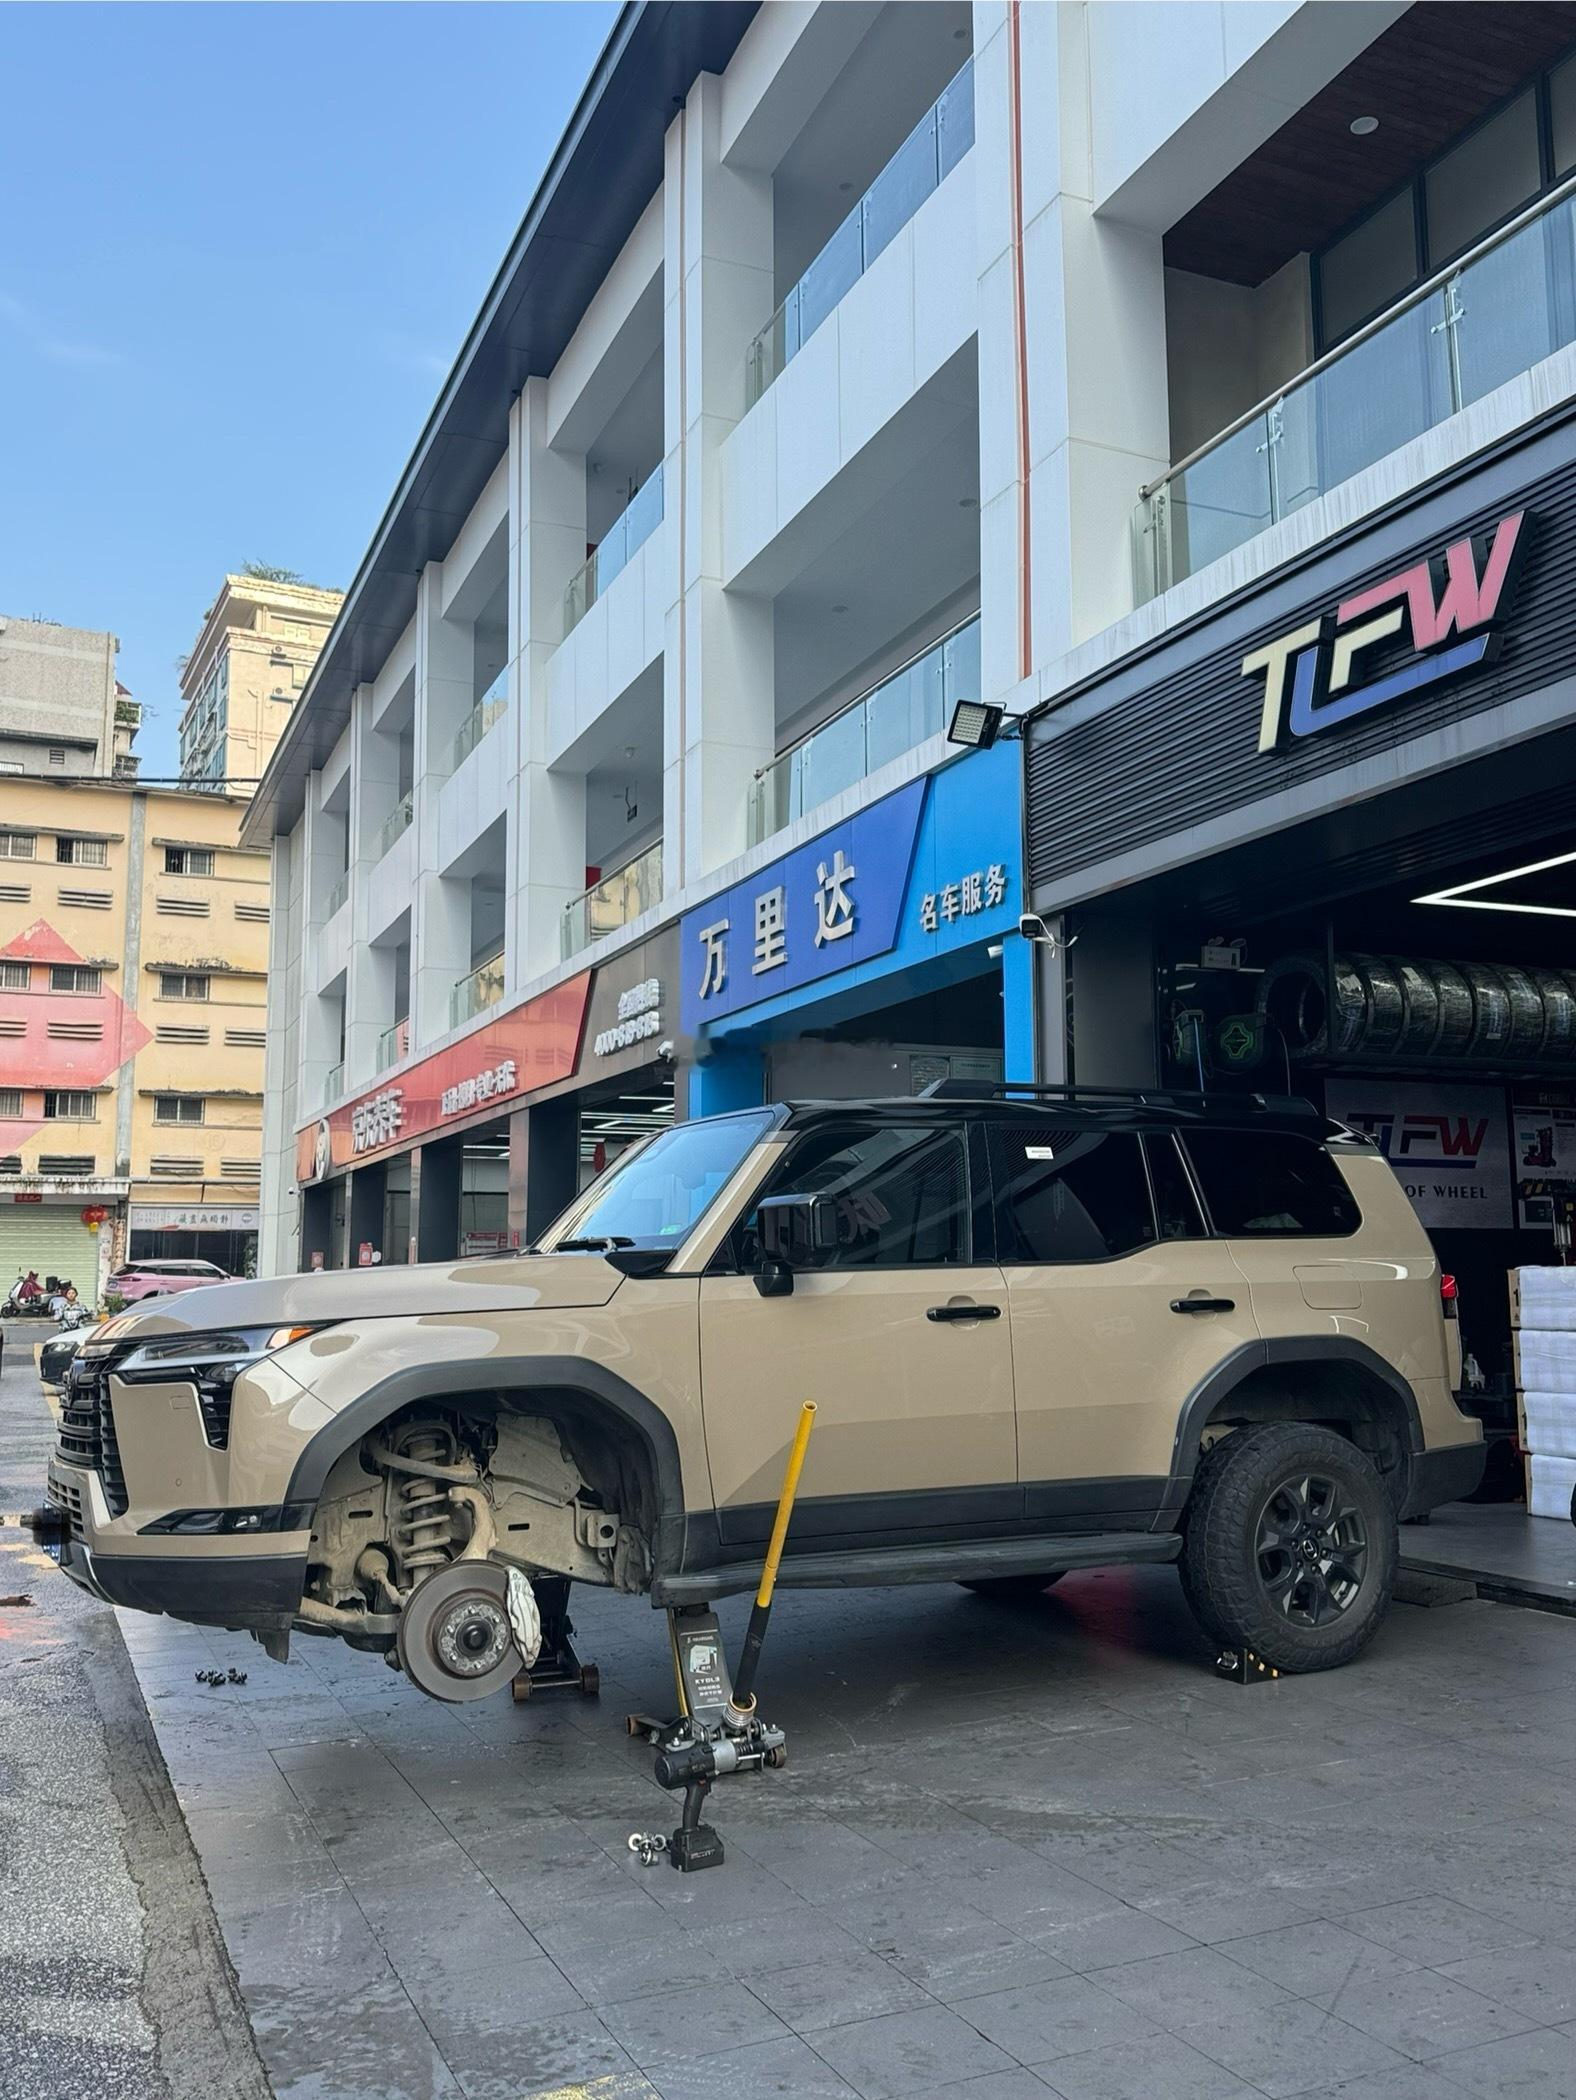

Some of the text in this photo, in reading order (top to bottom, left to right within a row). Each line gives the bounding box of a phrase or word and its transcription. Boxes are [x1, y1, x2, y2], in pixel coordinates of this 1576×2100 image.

[699, 850, 855, 999] 万里达
[919, 863, 1007, 932] 名车服务
[1404, 1184, 1488, 1199] OF WHEEL
